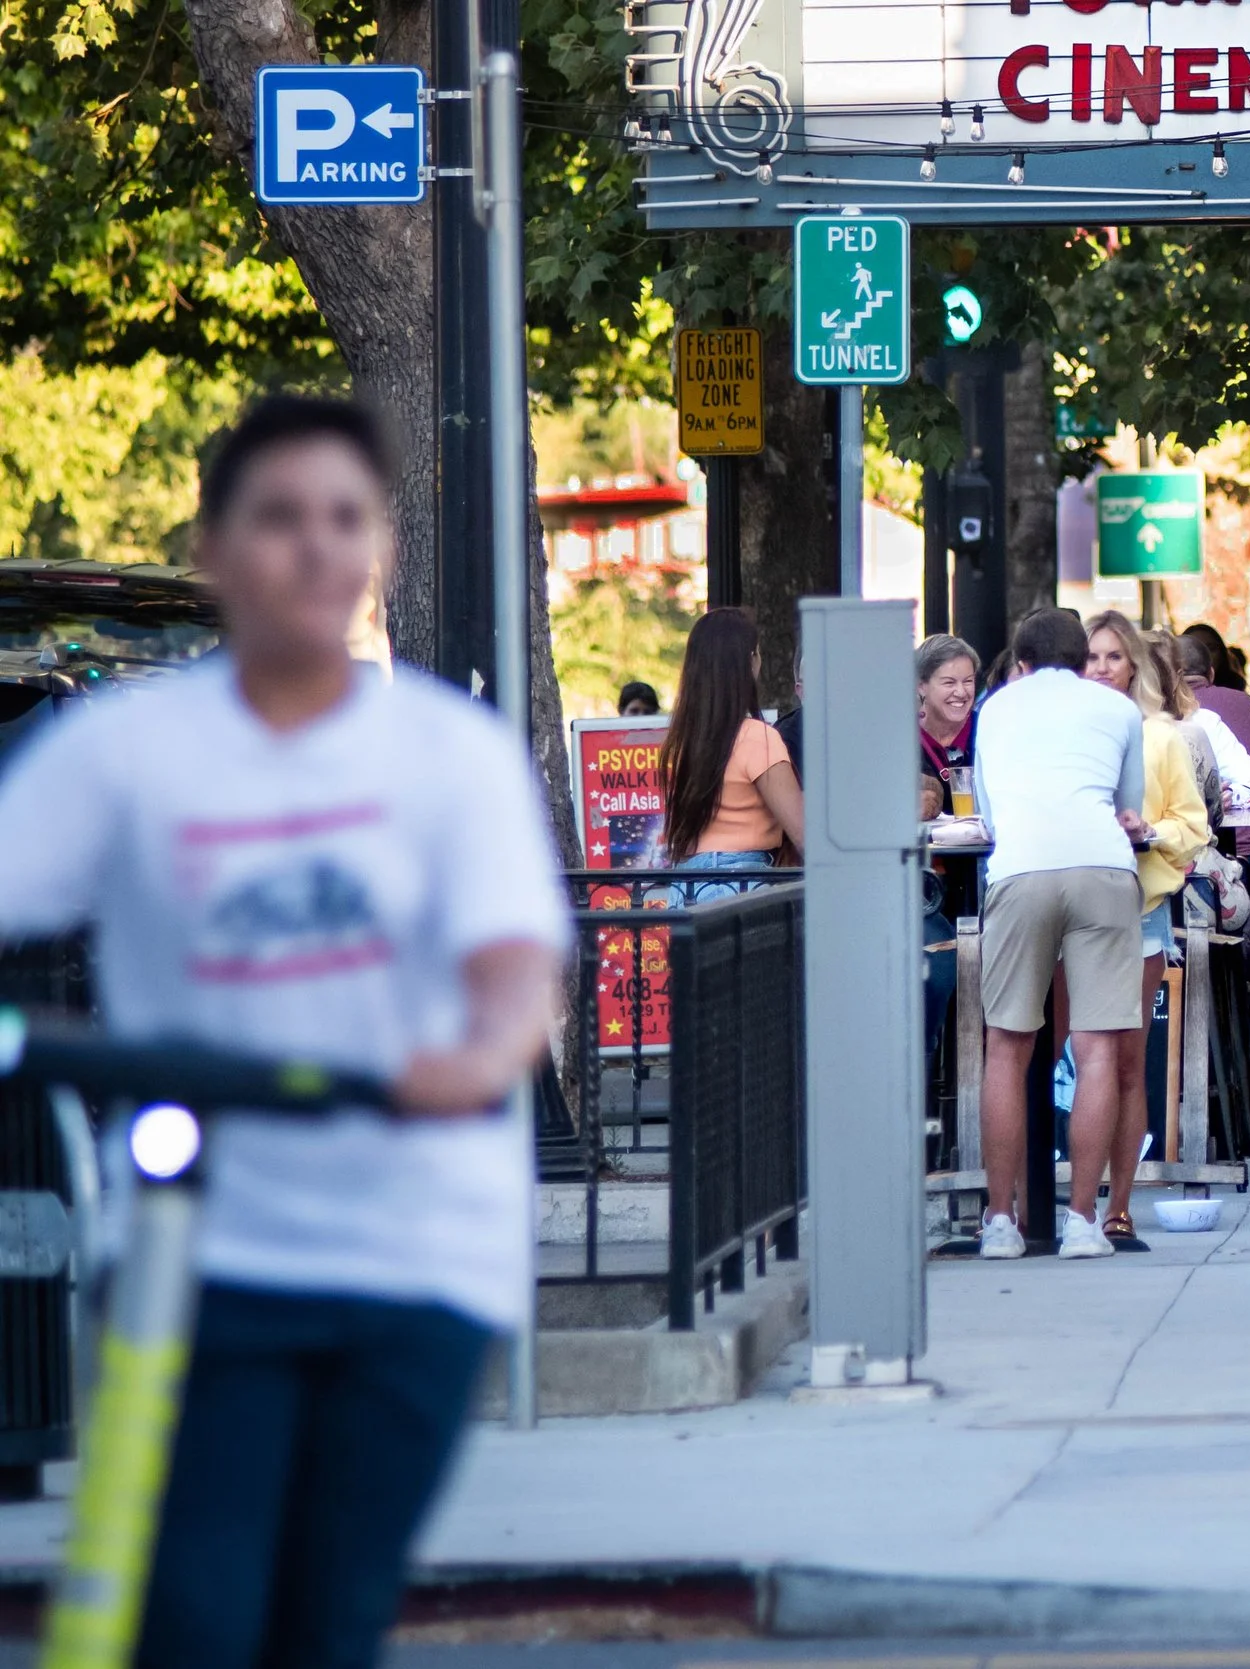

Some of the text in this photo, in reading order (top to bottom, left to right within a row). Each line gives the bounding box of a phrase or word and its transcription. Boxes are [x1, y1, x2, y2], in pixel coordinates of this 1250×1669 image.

[276, 89, 406, 182] PARKING
[828, 226, 877, 251] PED
[686, 333, 752, 356] FREIGHT
[808, 345, 897, 370] TUNNEL
[686, 358, 755, 381] LOADING
[701, 384, 742, 407] ZONE
[598, 747, 672, 771] PSYCH
[601, 771, 648, 790] WALK
[600, 791, 660, 812] Call Asia
